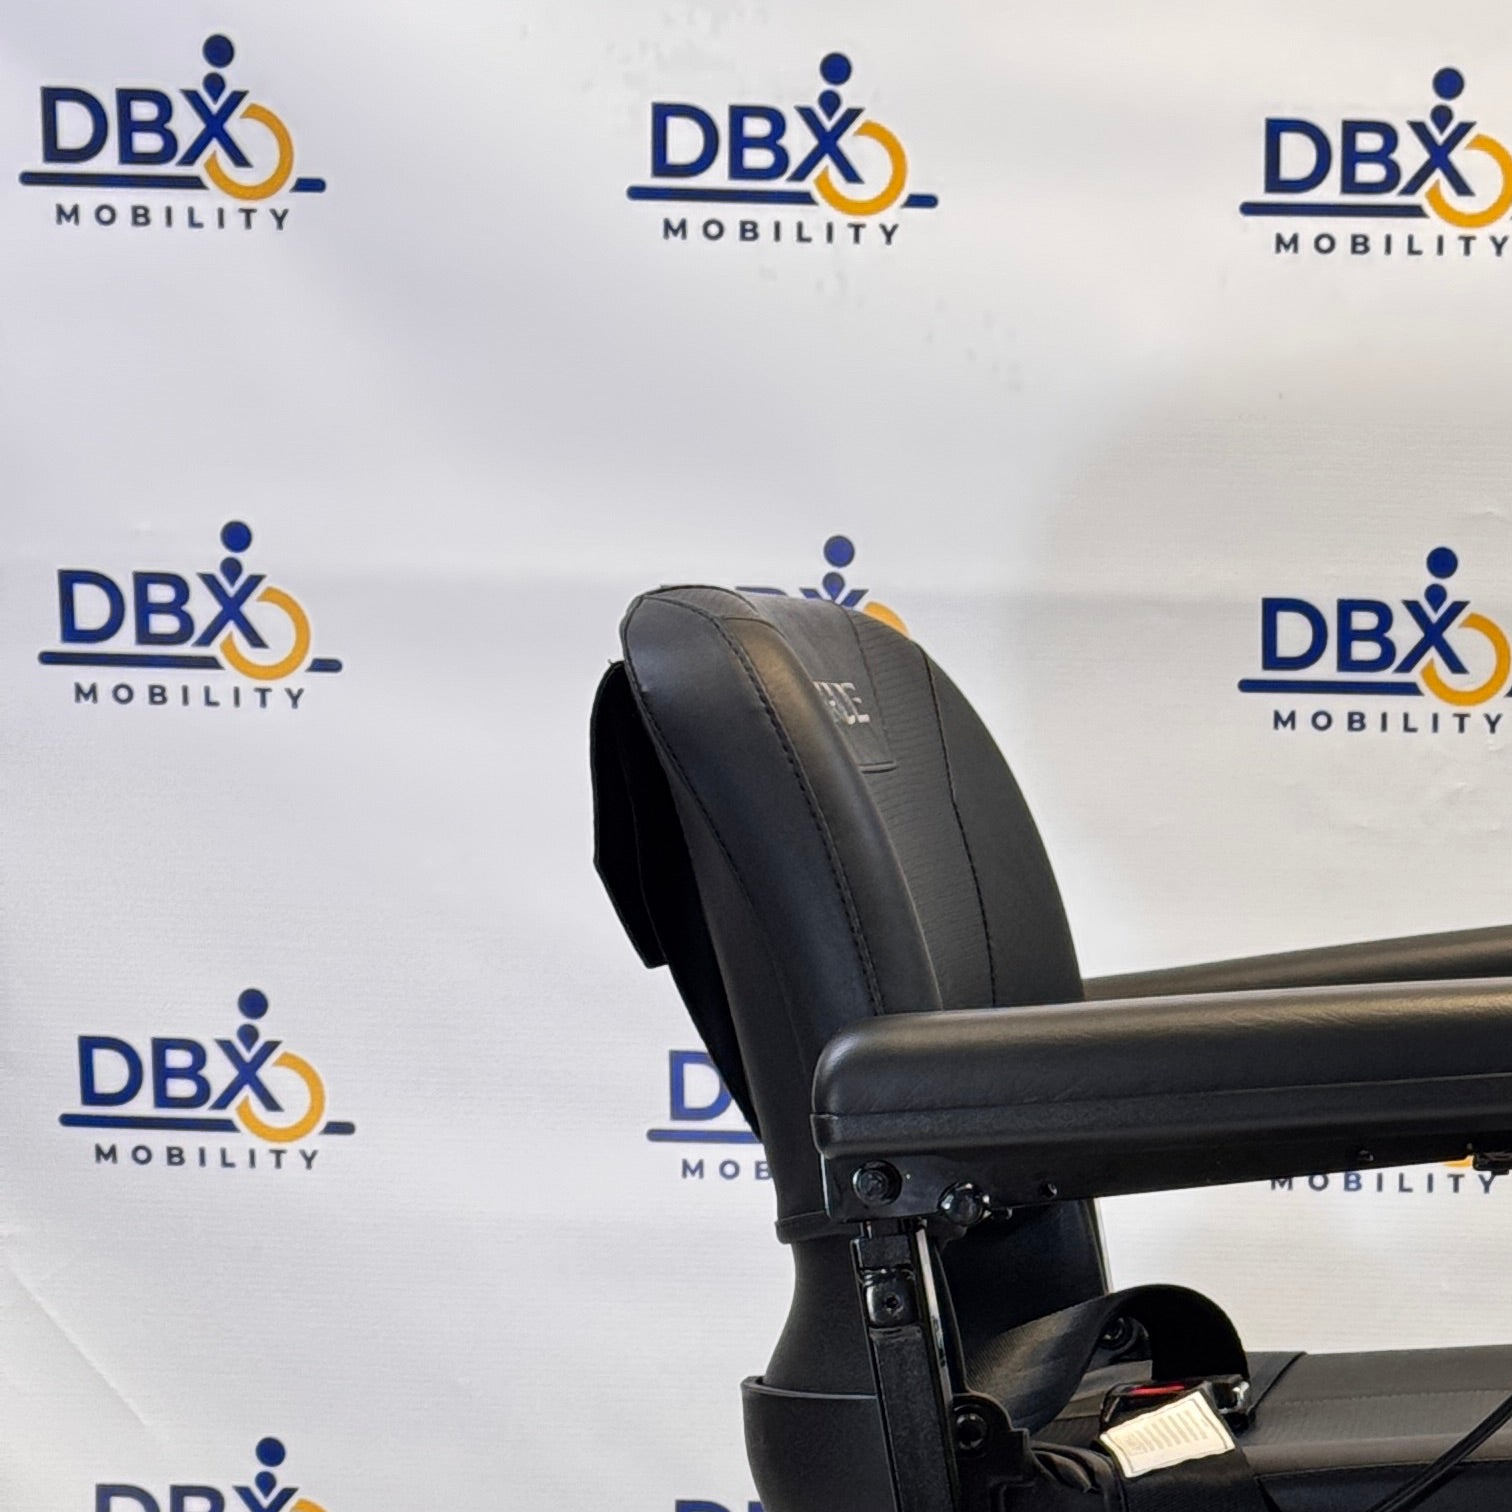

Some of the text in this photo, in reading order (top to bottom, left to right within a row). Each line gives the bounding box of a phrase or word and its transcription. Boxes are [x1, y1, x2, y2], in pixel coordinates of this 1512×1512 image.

[41, 86, 252, 167] DBX
[651, 101, 863, 183] DBX
[1264, 118, 1476, 196] DBX
[56, 204, 290, 230] MOBILITY
[663, 219, 900, 245] MOBILITY
[1275, 233, 1510, 257] MOBILITY
[58, 569, 267, 648] DBX
[1262, 598, 1471, 674] DBX
[74, 683, 305, 709] MOBILITY
[1273, 710, 1503, 733] MOBILITY
[78, 1035, 284, 1112] DBX
[95, 1144, 319, 1170] MOBILITY
[1271, 1172, 1496, 1194] MOBILITY
